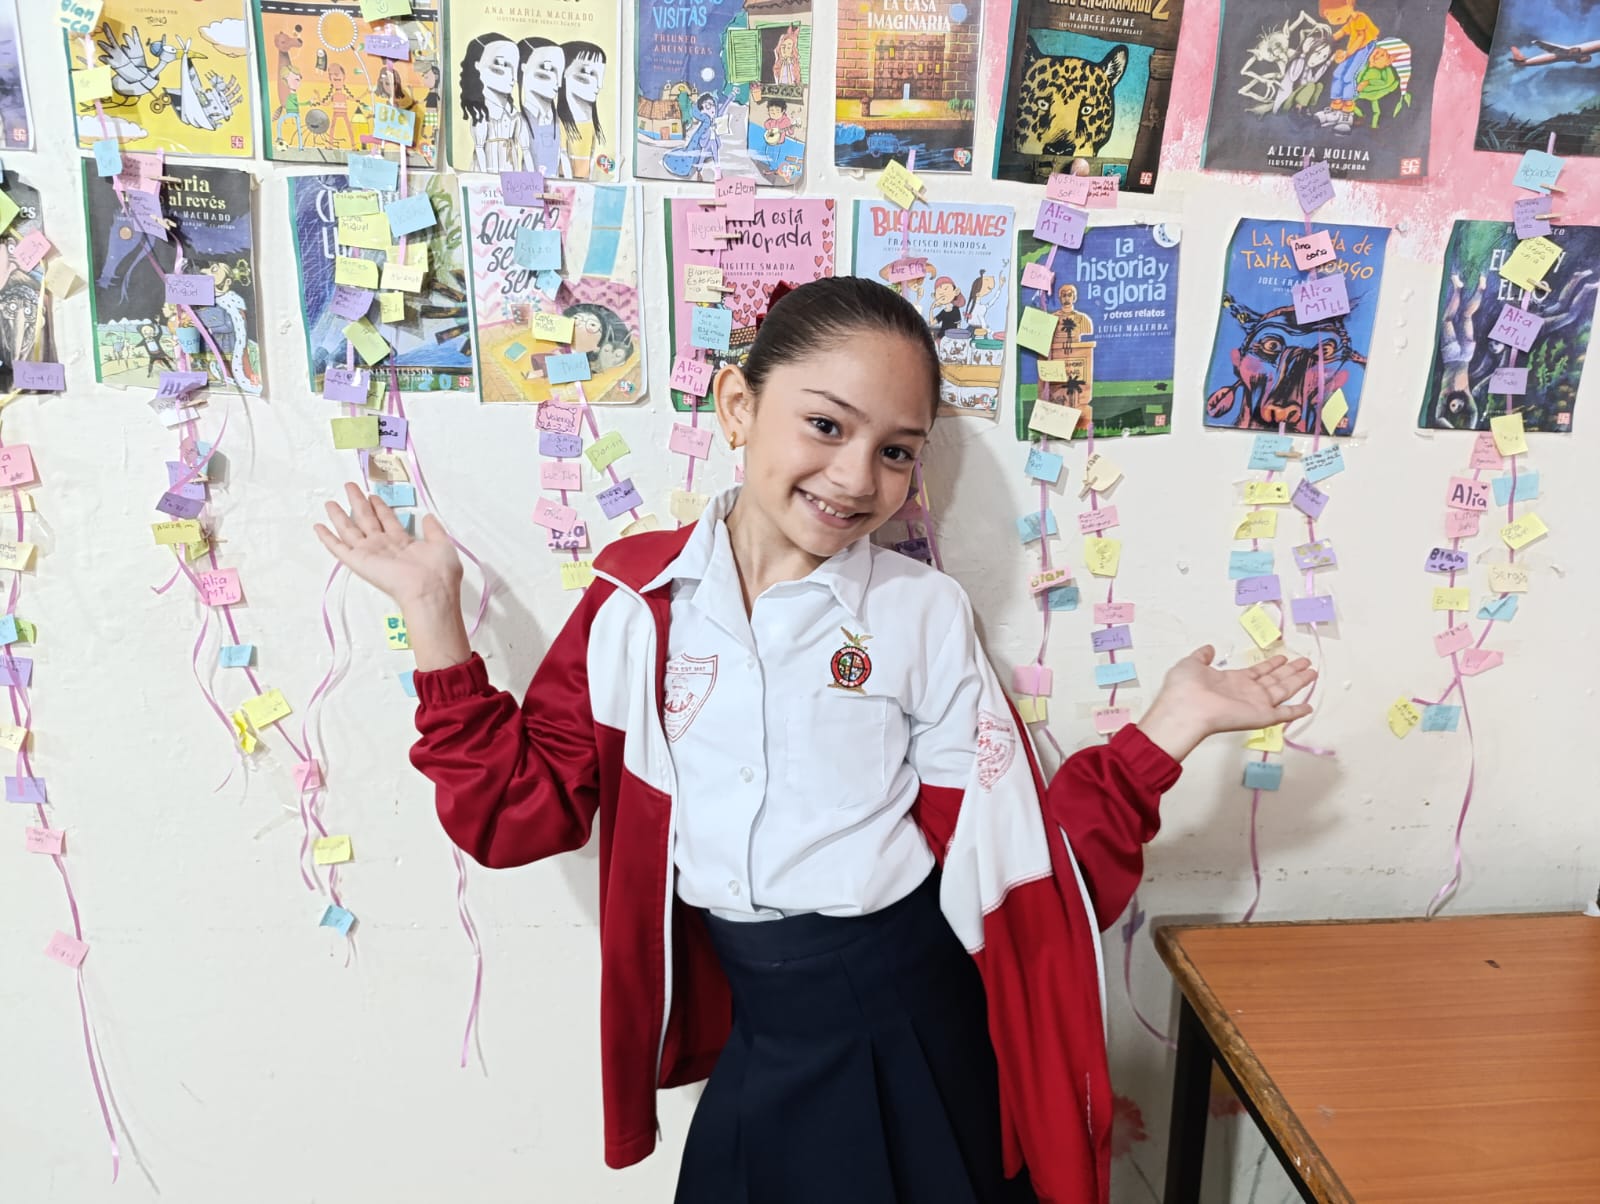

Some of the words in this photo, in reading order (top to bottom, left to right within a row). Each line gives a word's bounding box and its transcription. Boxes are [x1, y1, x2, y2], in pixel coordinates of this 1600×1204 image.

[485, 6, 504, 14] ANA
[547, 10, 594, 21] MACHADO
[884, 0, 900, 11] LA
[903, 0, 937, 12] CASA
[653, 6, 707, 29] VISITAS
[867, 11, 951, 31] IMAGINARIA
[1069, 12, 1105, 24] MARCEL
[654, 33, 696, 44] TRIUNFO
[654, 44, 712, 55] ARCINIEGAS
[1267, 145, 1315, 158] ALICIA
[1323, 148, 1370, 161] MOLINA
[1268, 159, 1305, 167] ILUSTRAD
[169, 191, 182, 206] al
[186, 192, 226, 209] revés
[183, 210, 231, 222] MACHADO
[771, 207, 803, 225] está
[870, 207, 1007, 237] BUSCALACRANES
[943, 240, 987, 250] HINOJOSA
[1116, 238, 1134, 257] La
[1252, 229, 1273, 247] La
[1353, 235, 1374, 256] de
[1240, 248, 1292, 269] Taita
[720, 262, 755, 271] RIGITTE
[1077, 254, 1156, 281] historia
[1158, 263, 1169, 281] y
[1258, 276, 1278, 285] JOEL
[1088, 283, 1101, 299] la
[1104, 280, 1166, 310] gloria
[1109, 311, 1132, 319] otros
[1135, 309, 1165, 318] relatos
[1098, 325, 1122, 333] LUIGI
[1126, 323, 1168, 332] MALERBA
[1452, 484, 1487, 508] Alia
